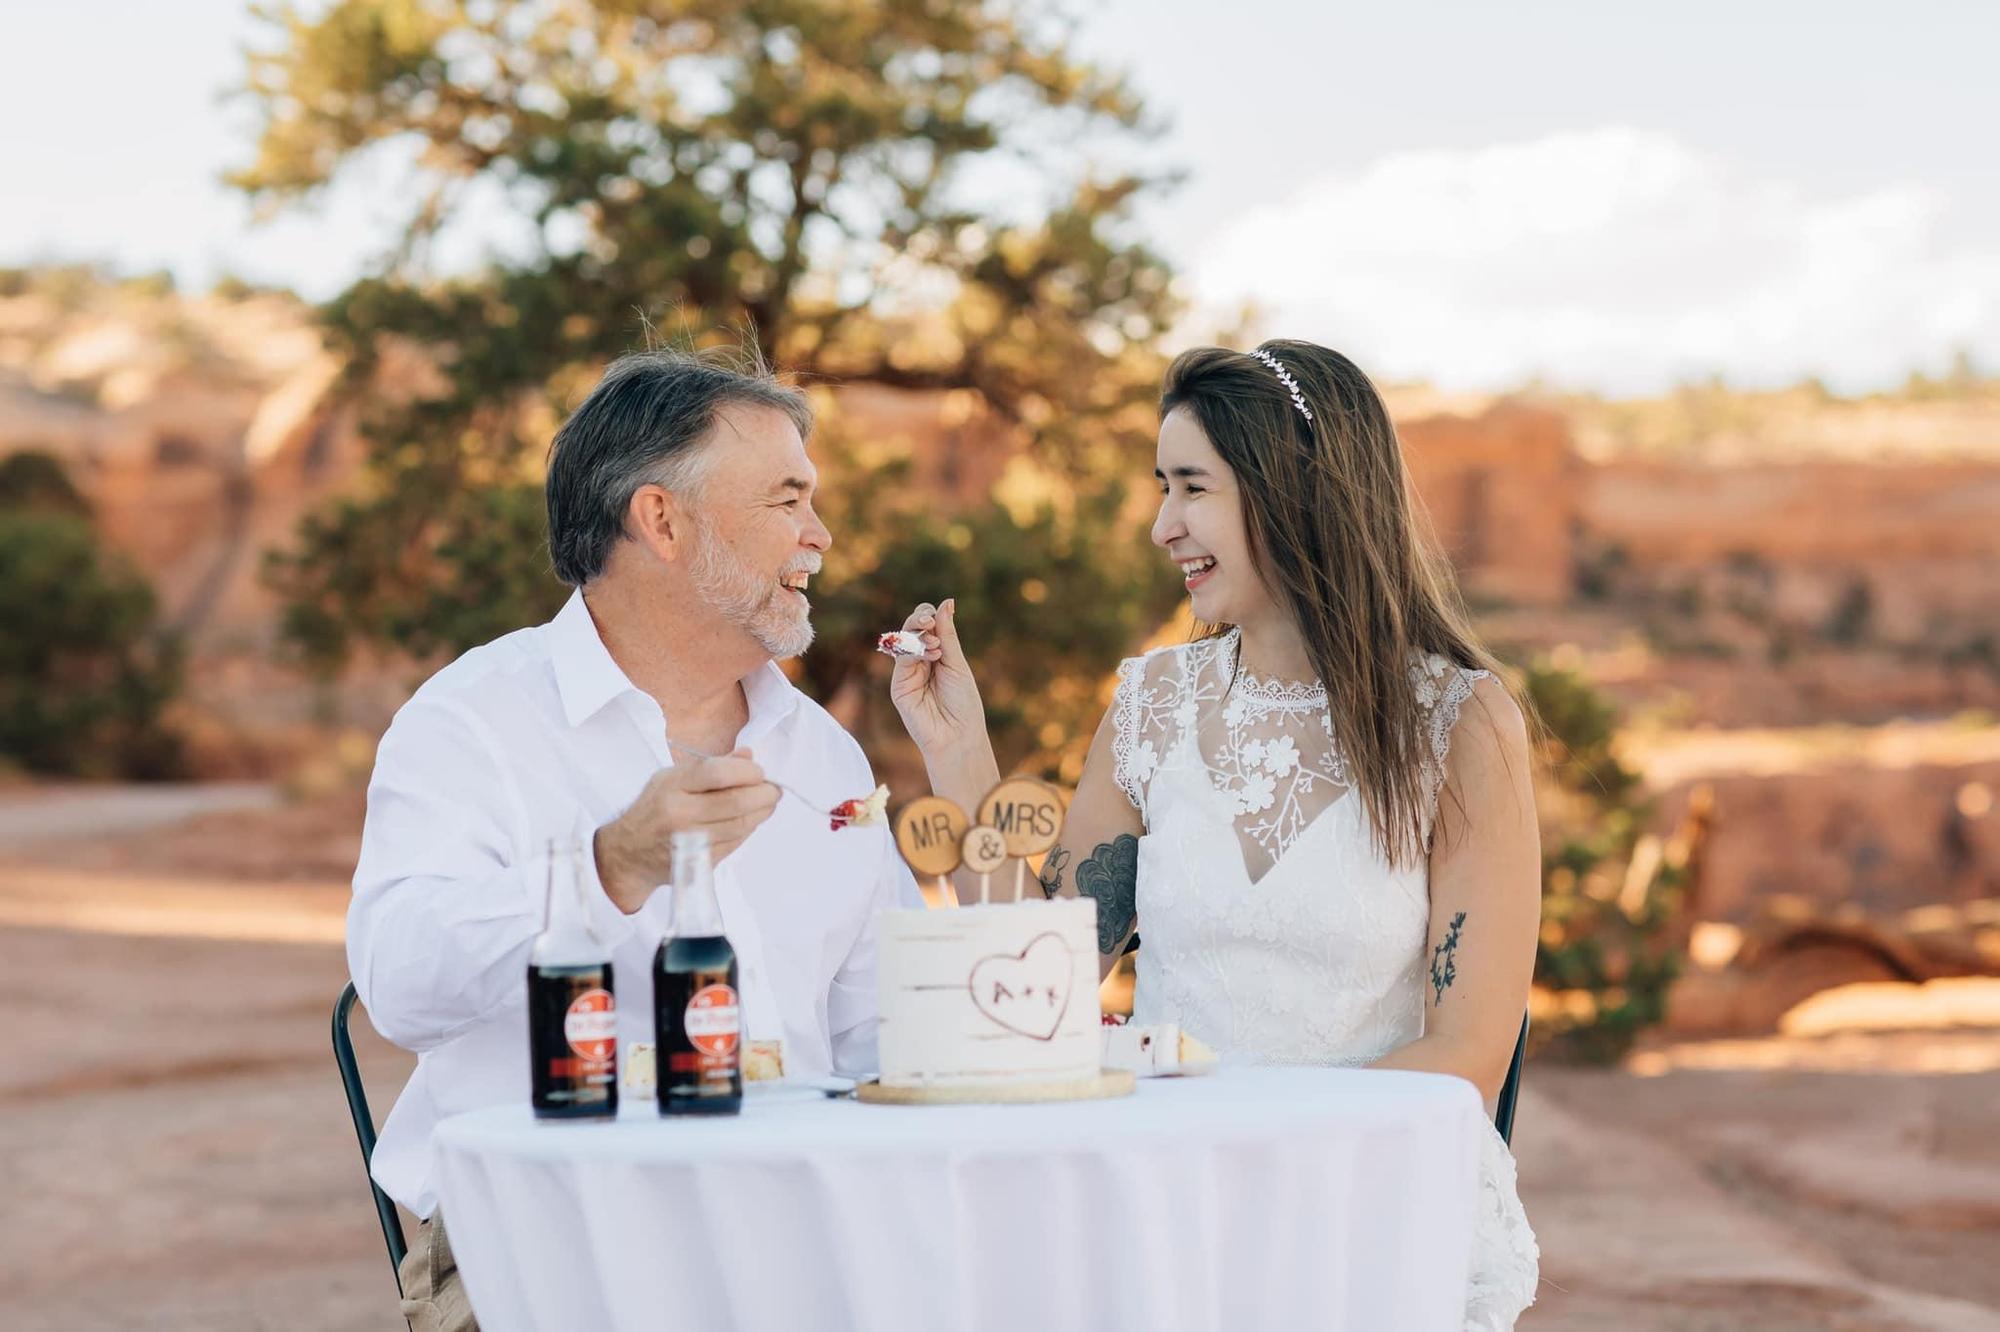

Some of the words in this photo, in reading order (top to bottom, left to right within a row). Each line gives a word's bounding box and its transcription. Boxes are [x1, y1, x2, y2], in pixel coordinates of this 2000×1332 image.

[910, 812, 955, 851] MR
[978, 834, 1002, 861] &
[993, 801, 1056, 837] MRS
